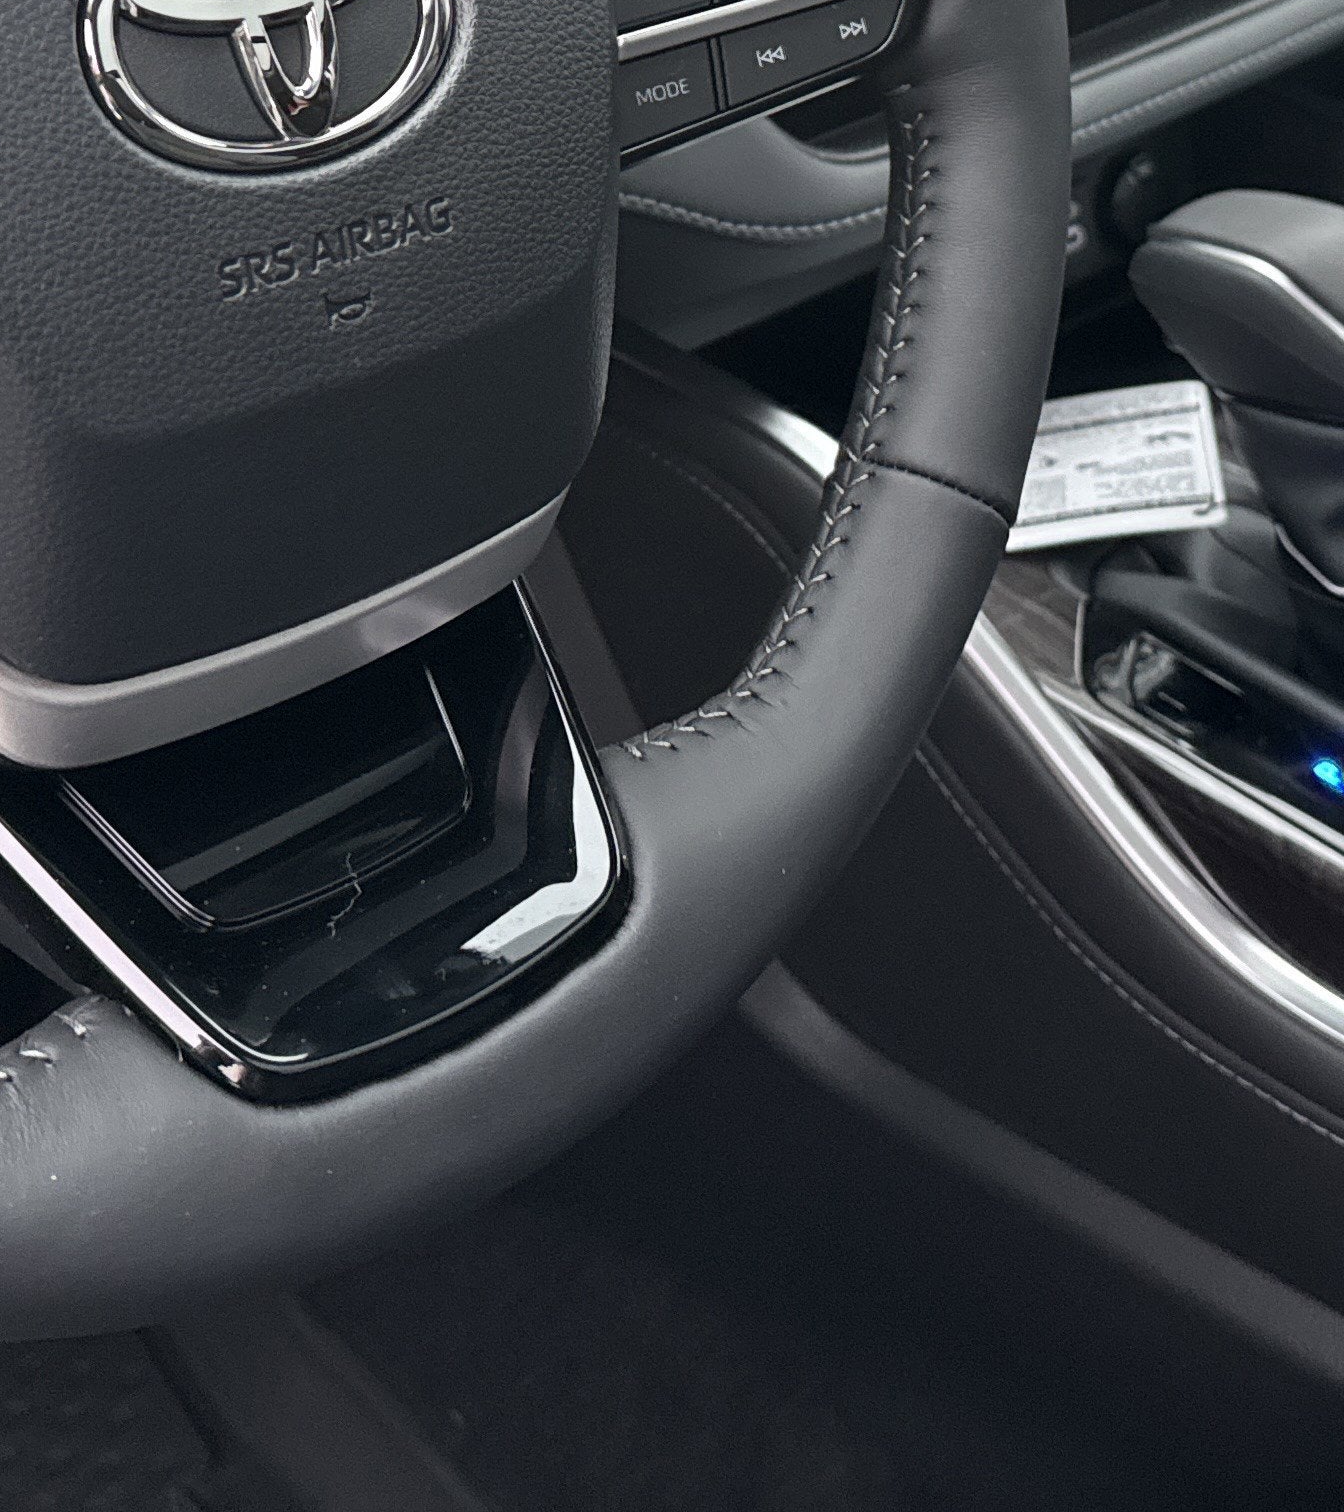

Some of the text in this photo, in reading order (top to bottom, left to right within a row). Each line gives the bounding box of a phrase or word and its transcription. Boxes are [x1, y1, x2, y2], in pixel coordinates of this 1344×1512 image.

[634, 78, 691, 107] MODE
[217, 195, 456, 303] SRS AIRBAG
